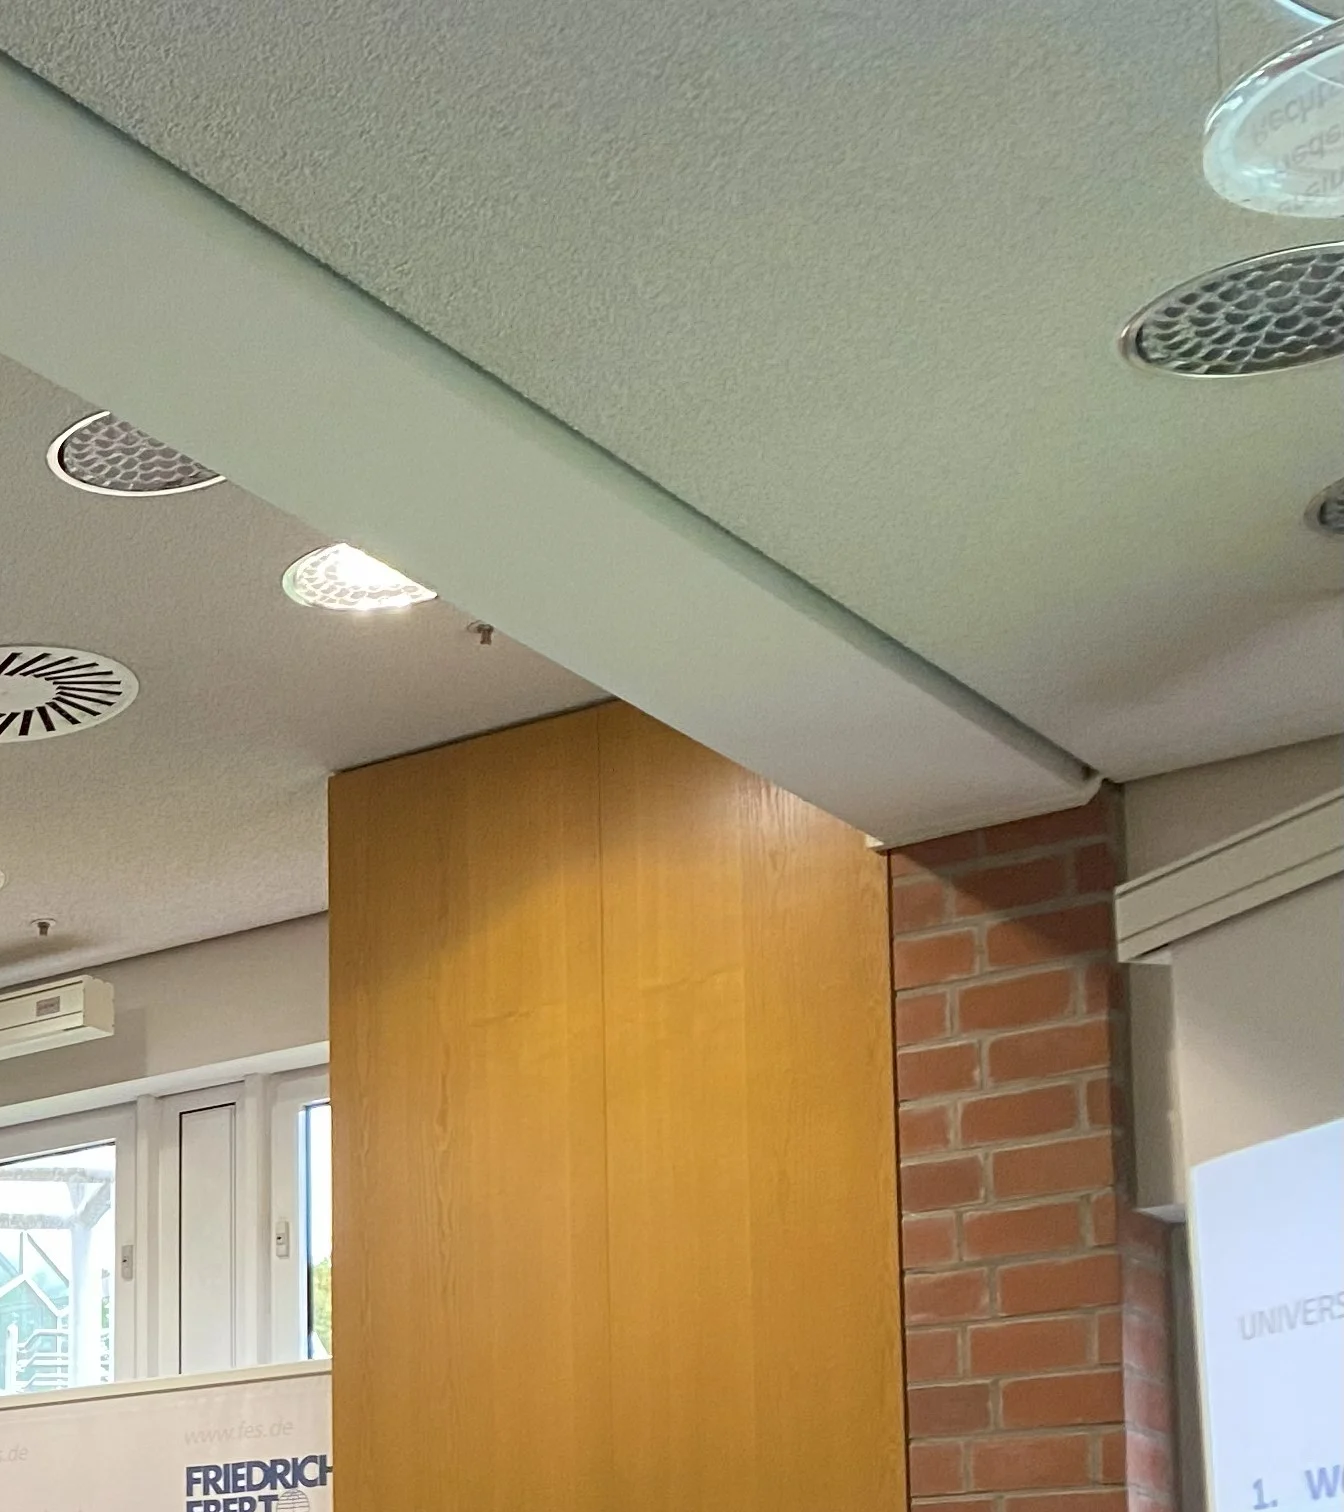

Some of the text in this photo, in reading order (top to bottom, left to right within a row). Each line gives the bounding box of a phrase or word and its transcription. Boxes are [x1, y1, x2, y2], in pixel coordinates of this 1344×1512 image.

[185, 1419, 293, 1445] www.fes.de
[186, 1454, 333, 1496] FRIEDRICH
[1253, 1478, 1278, 1511] 1.
